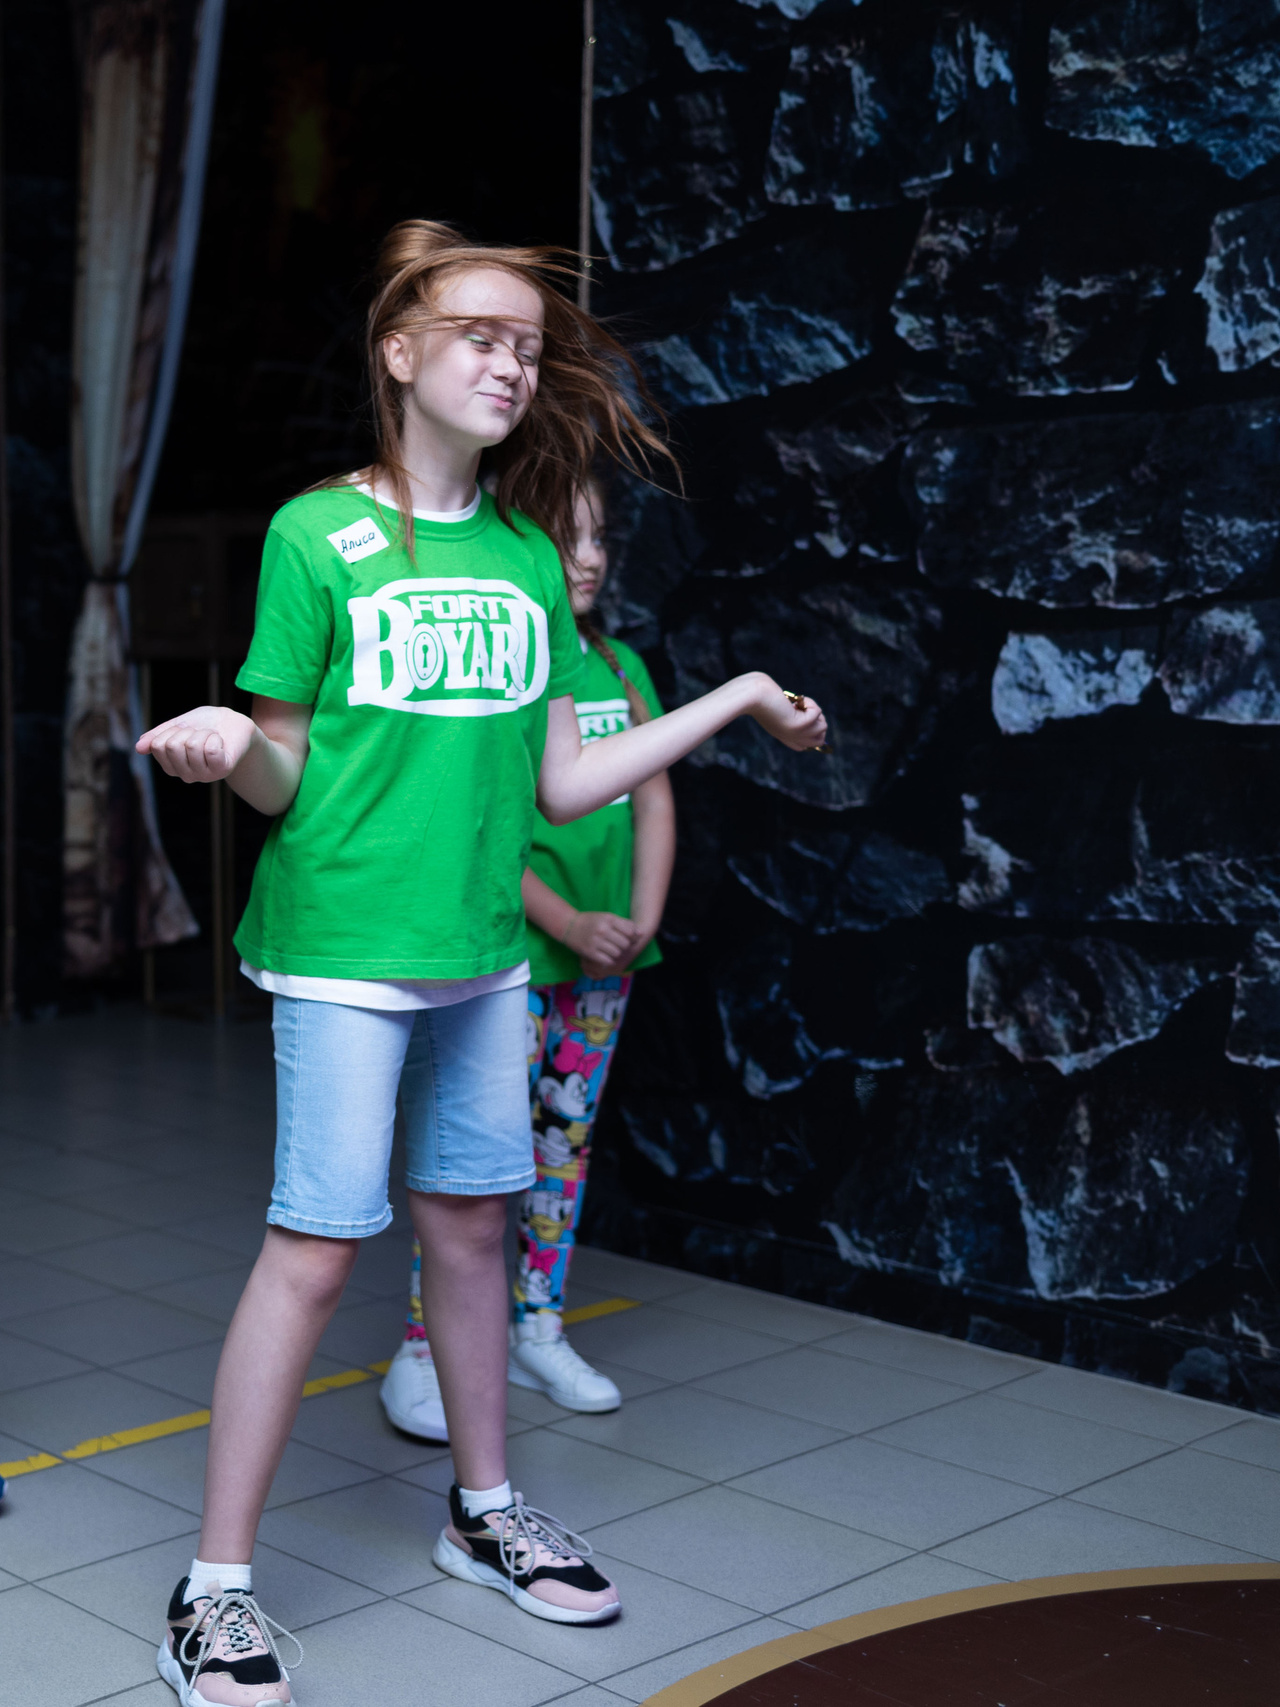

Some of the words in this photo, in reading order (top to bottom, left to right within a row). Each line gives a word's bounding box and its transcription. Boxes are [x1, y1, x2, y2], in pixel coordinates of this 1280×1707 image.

[341, 531, 376, 554] Алиса
[408, 594, 504, 621] FORT
[347, 595, 550, 707] BOYARD
